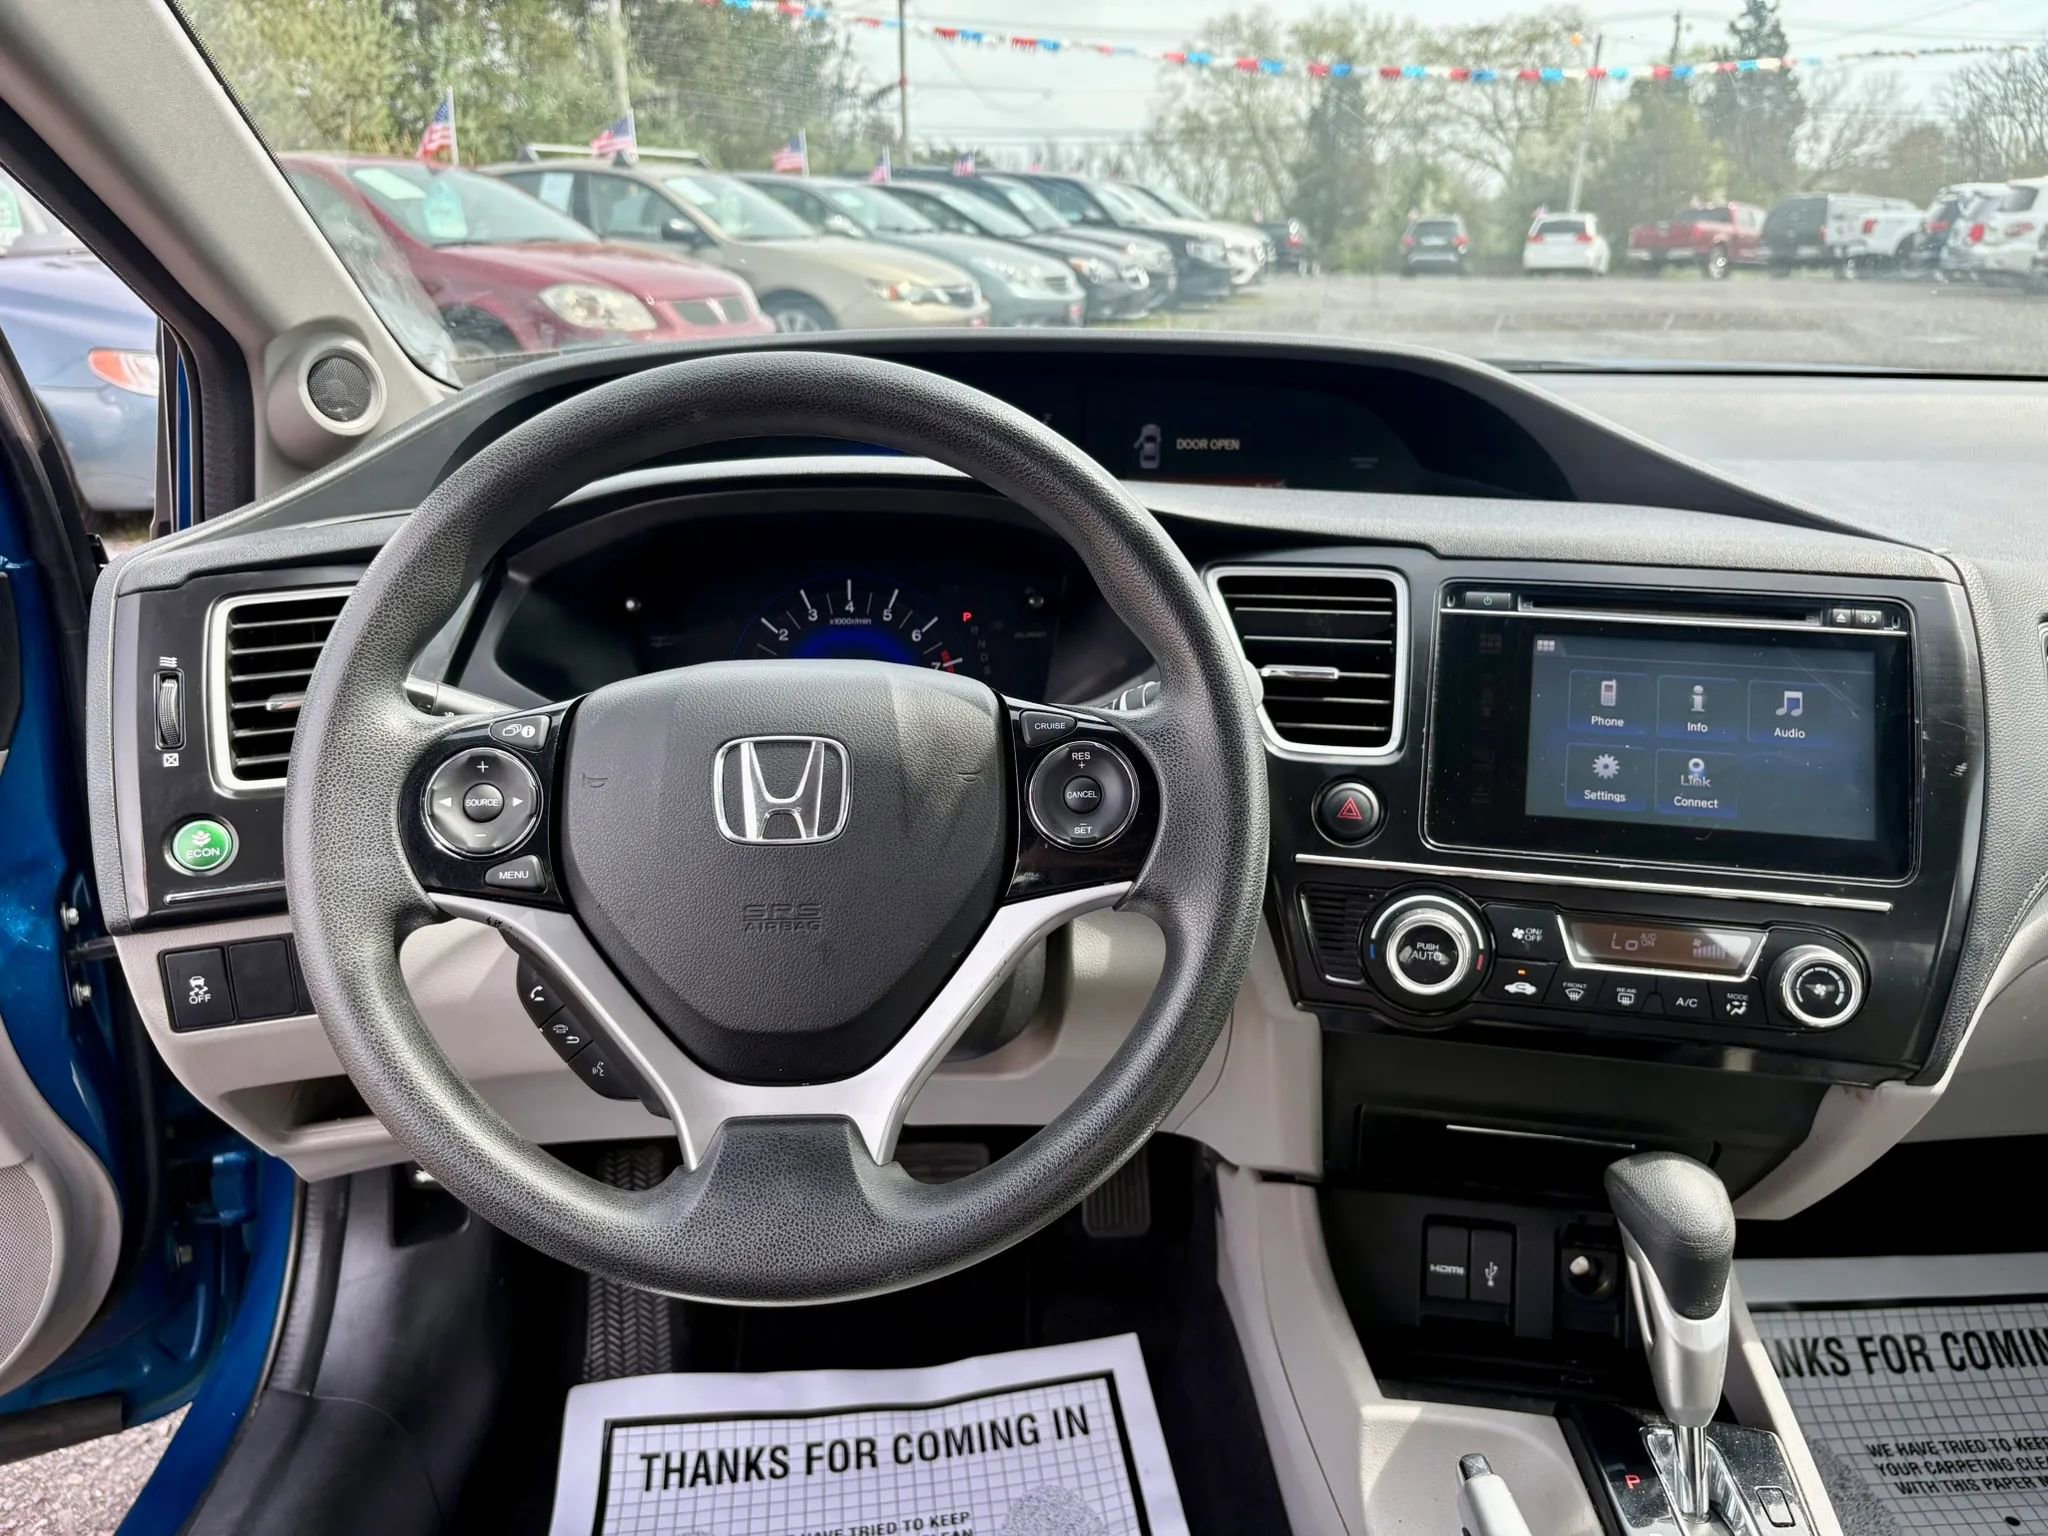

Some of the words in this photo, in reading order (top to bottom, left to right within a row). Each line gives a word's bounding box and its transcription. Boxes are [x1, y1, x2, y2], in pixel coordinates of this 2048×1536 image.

[1176, 438, 1208, 451] DOOR
[1210, 438, 1240, 451] OPEN
[845, 601, 855, 613] 4
[808, 609, 818, 621] 3
[882, 609, 893, 621] 5
[963, 612, 972, 622] P
[779, 629, 789, 641] 2
[911, 629, 922, 642] 6
[1034, 722, 1066, 730] CRUISE
[1591, 715, 1624, 727] Phone
[1687, 722, 1708, 733] Info
[1774, 727, 1805, 739] Audio
[1072, 752, 1091, 760] RES
[1680, 774, 1711, 787] Link
[1066, 791, 1098, 799] CANCEL
[1584, 790, 1626, 803] Settings
[465, 799, 499, 807] SOURCE
[1673, 796, 1718, 808] Connect
[1074, 826, 1092, 834] SET
[186, 847, 220, 859] ECON
[499, 870, 529, 880] MENU
[1524, 934, 1543, 942] OFF
[1611, 932, 1639, 950] Lo
[1416, 942, 1439, 950] PUSH
[1411, 951, 1442, 960] AUTO
[189, 993, 212, 1004] OFF
[1675, 997, 1698, 1007] A/C
[1430, 1263, 1465, 1275] HDMI
[1761, 1337, 1850, 1377] NKS
[1857, 1334, 1934, 1375] FOR
[640, 1444, 790, 1492] THANKS
[806, 1437, 878, 1475] FOR
[893, 1413, 1040, 1464] COMING
[1053, 1404, 1090, 1440] IN
[1865, 1443, 1894, 1457] WE
[1895, 1441, 1939, 1456] HAVE
[1938, 1440, 1987, 1454] TRIED
[1988, 1438, 2011, 1452] TO
[1874, 1462, 1922, 1476] YOUR
[1924, 1458, 2014, 1475] CARPETING
[2015, 1456, 2048, 1470] CLE
[1625, 1474, 1641, 1489] P
[1894, 1481, 1940, 1494] WITH
[1939, 1479, 1980, 1492] THIS
[1980, 1477, 2037, 1490] PAPER
[848, 1522, 897, 1536] TRIED
[903, 1518, 923, 1531] TO
[929, 1511, 970, 1528] KEEP
